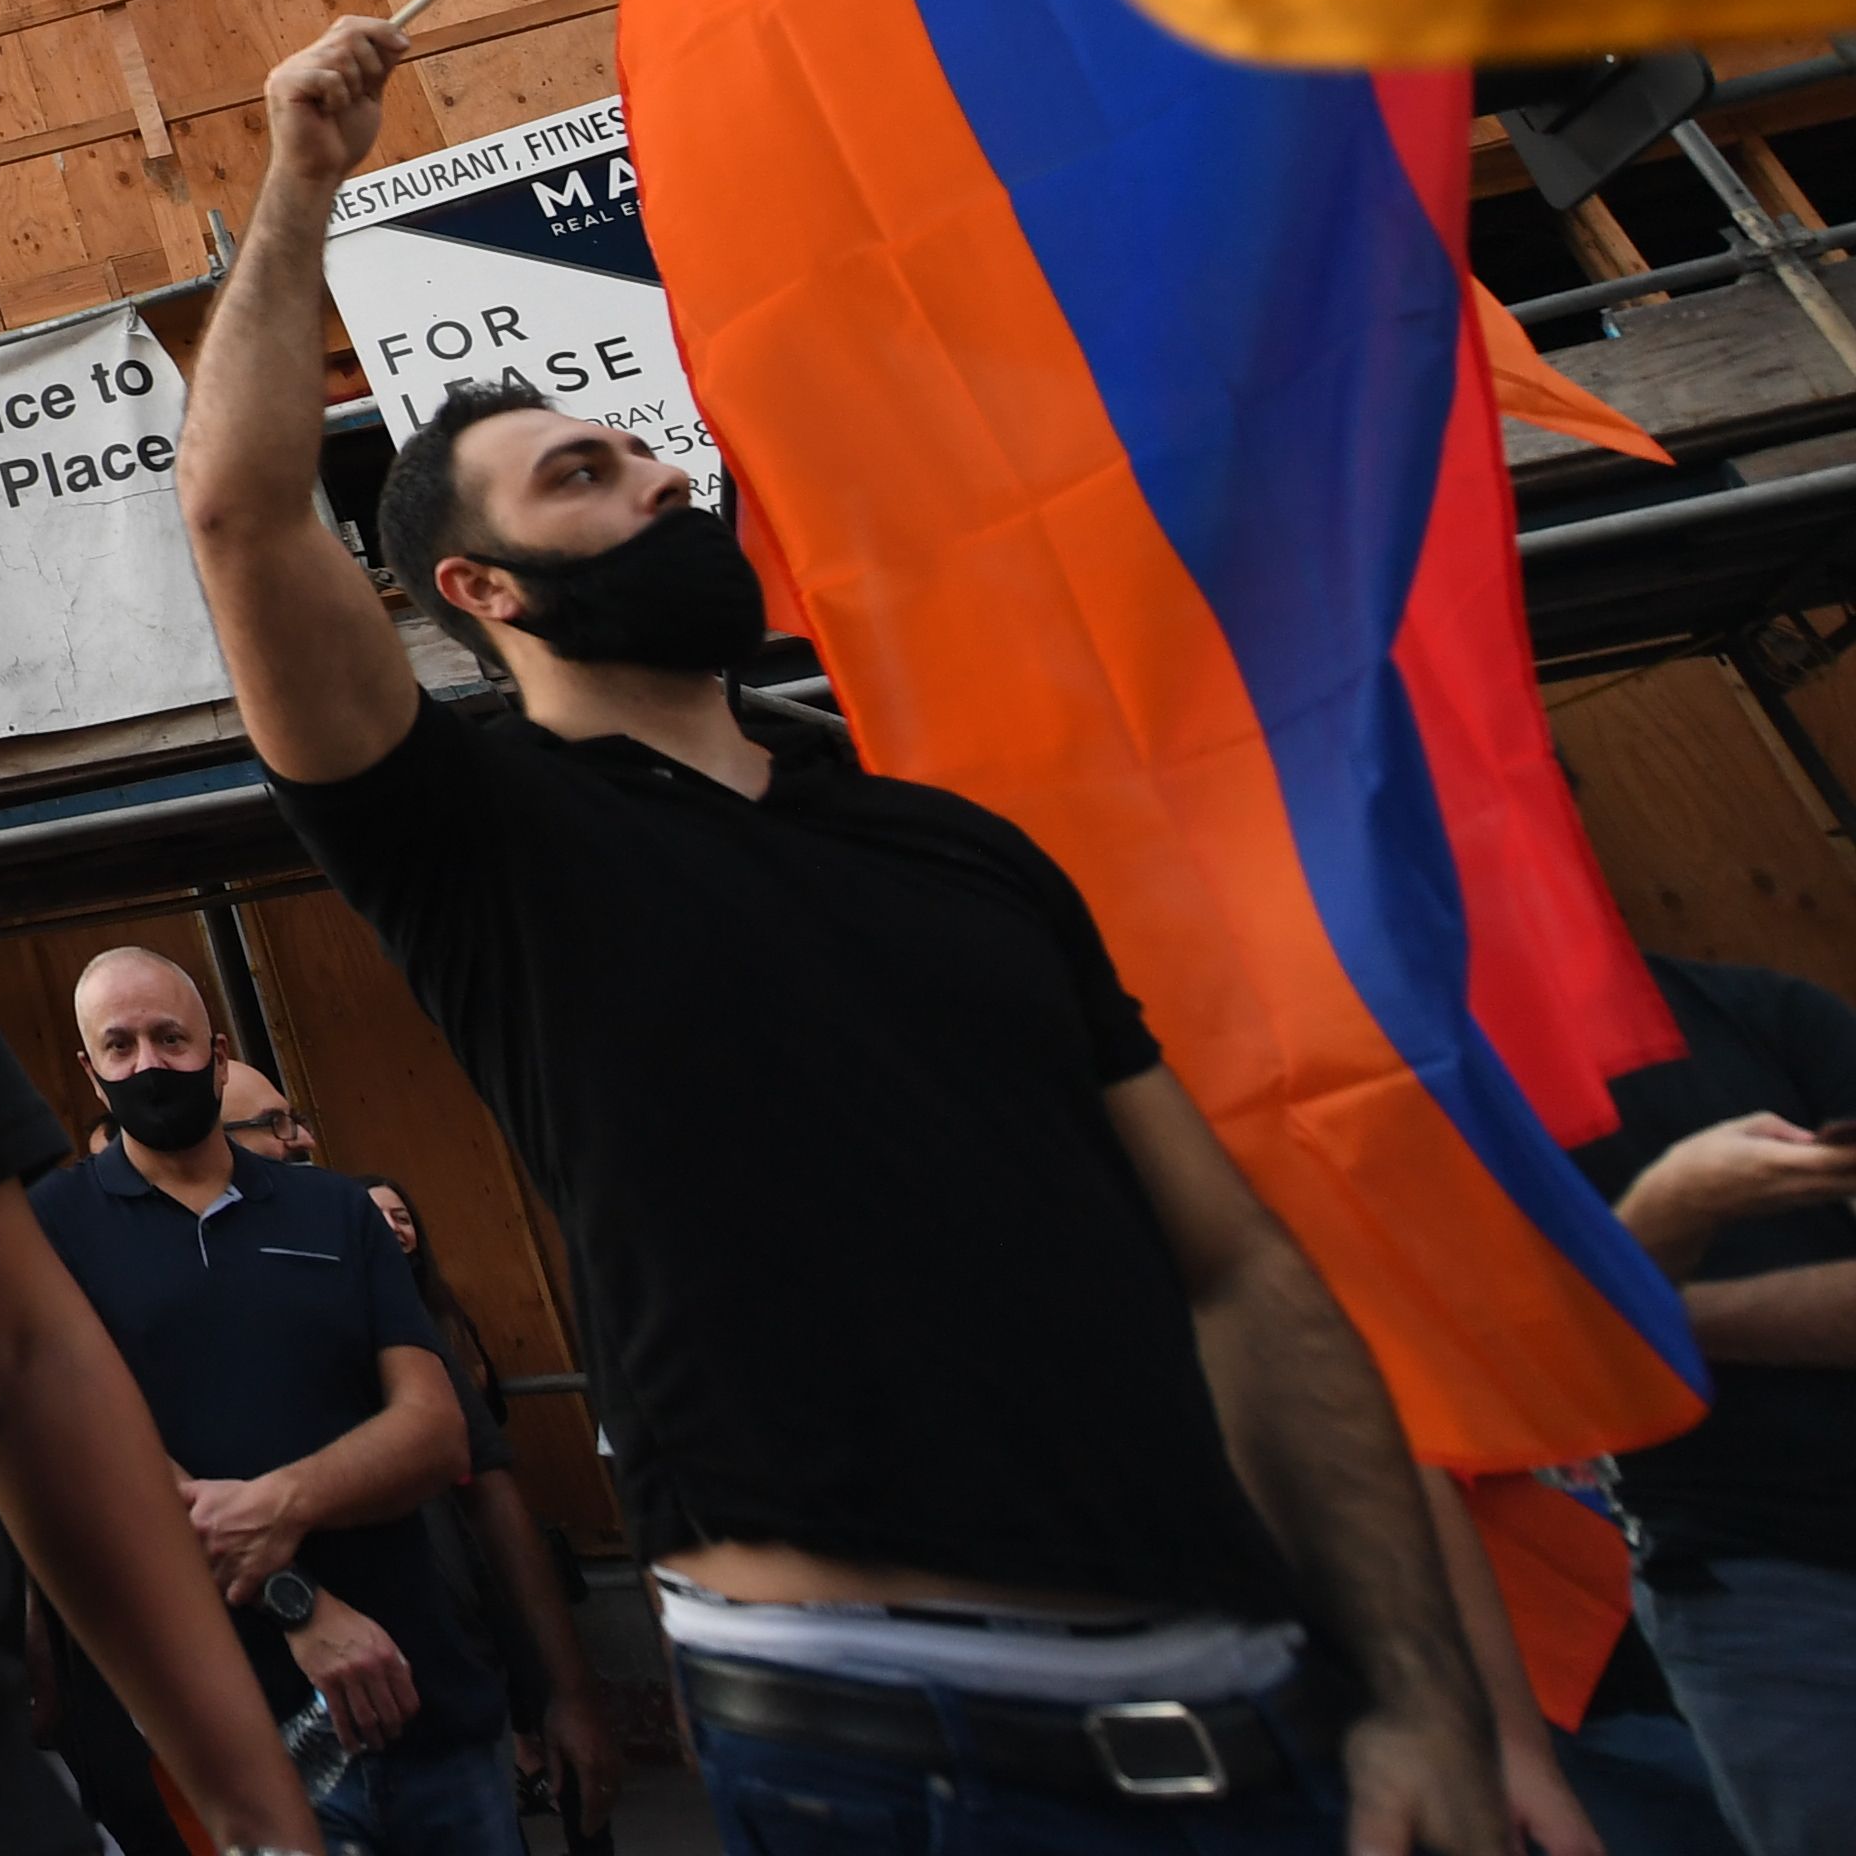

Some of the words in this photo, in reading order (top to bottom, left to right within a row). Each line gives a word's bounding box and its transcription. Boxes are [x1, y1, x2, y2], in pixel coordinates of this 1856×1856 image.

[523, 105, 627, 162] FITNES
[531, 156, 638, 219] MA
[550, 210, 616, 237] REAL
[377, 304, 530, 376] FOR
[89, 356, 155, 405] to
[584, 399, 665, 430] RAY
